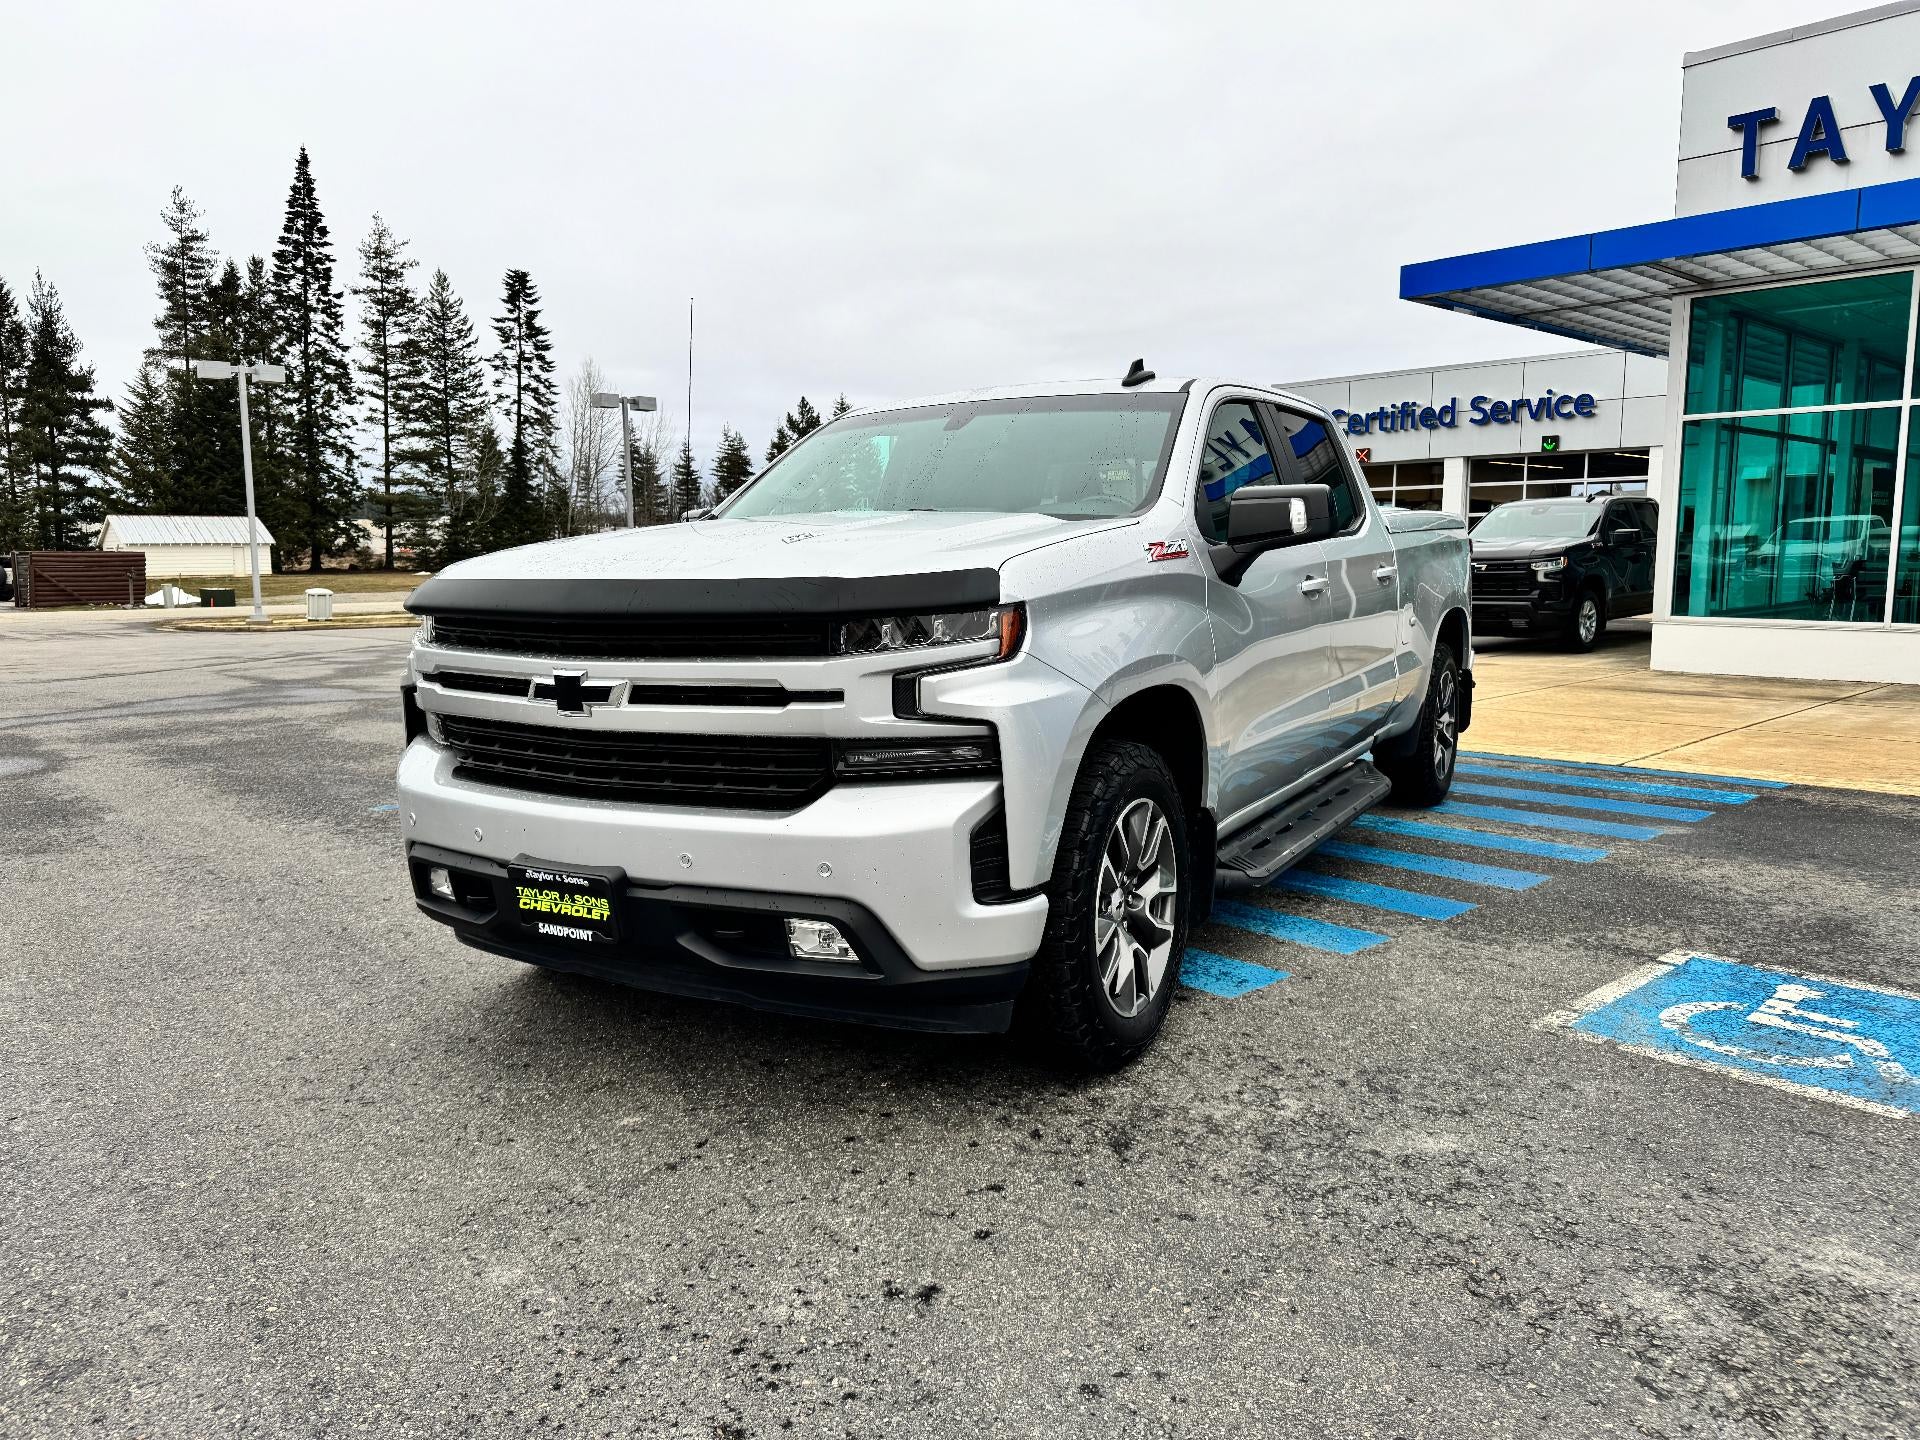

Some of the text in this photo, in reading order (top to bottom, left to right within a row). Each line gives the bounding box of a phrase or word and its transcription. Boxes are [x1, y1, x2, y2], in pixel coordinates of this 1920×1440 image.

[1728, 75, 1920, 179] TAY
[1469, 388, 1597, 426] Service
[1142, 538, 1190, 563] Z71
[525, 869, 554, 882] Taylor
[515, 886, 610, 909] TAYLOR & SONS
[519, 898, 611, 922] CHEVROLET
[538, 922, 593, 942] SANDPOINT
